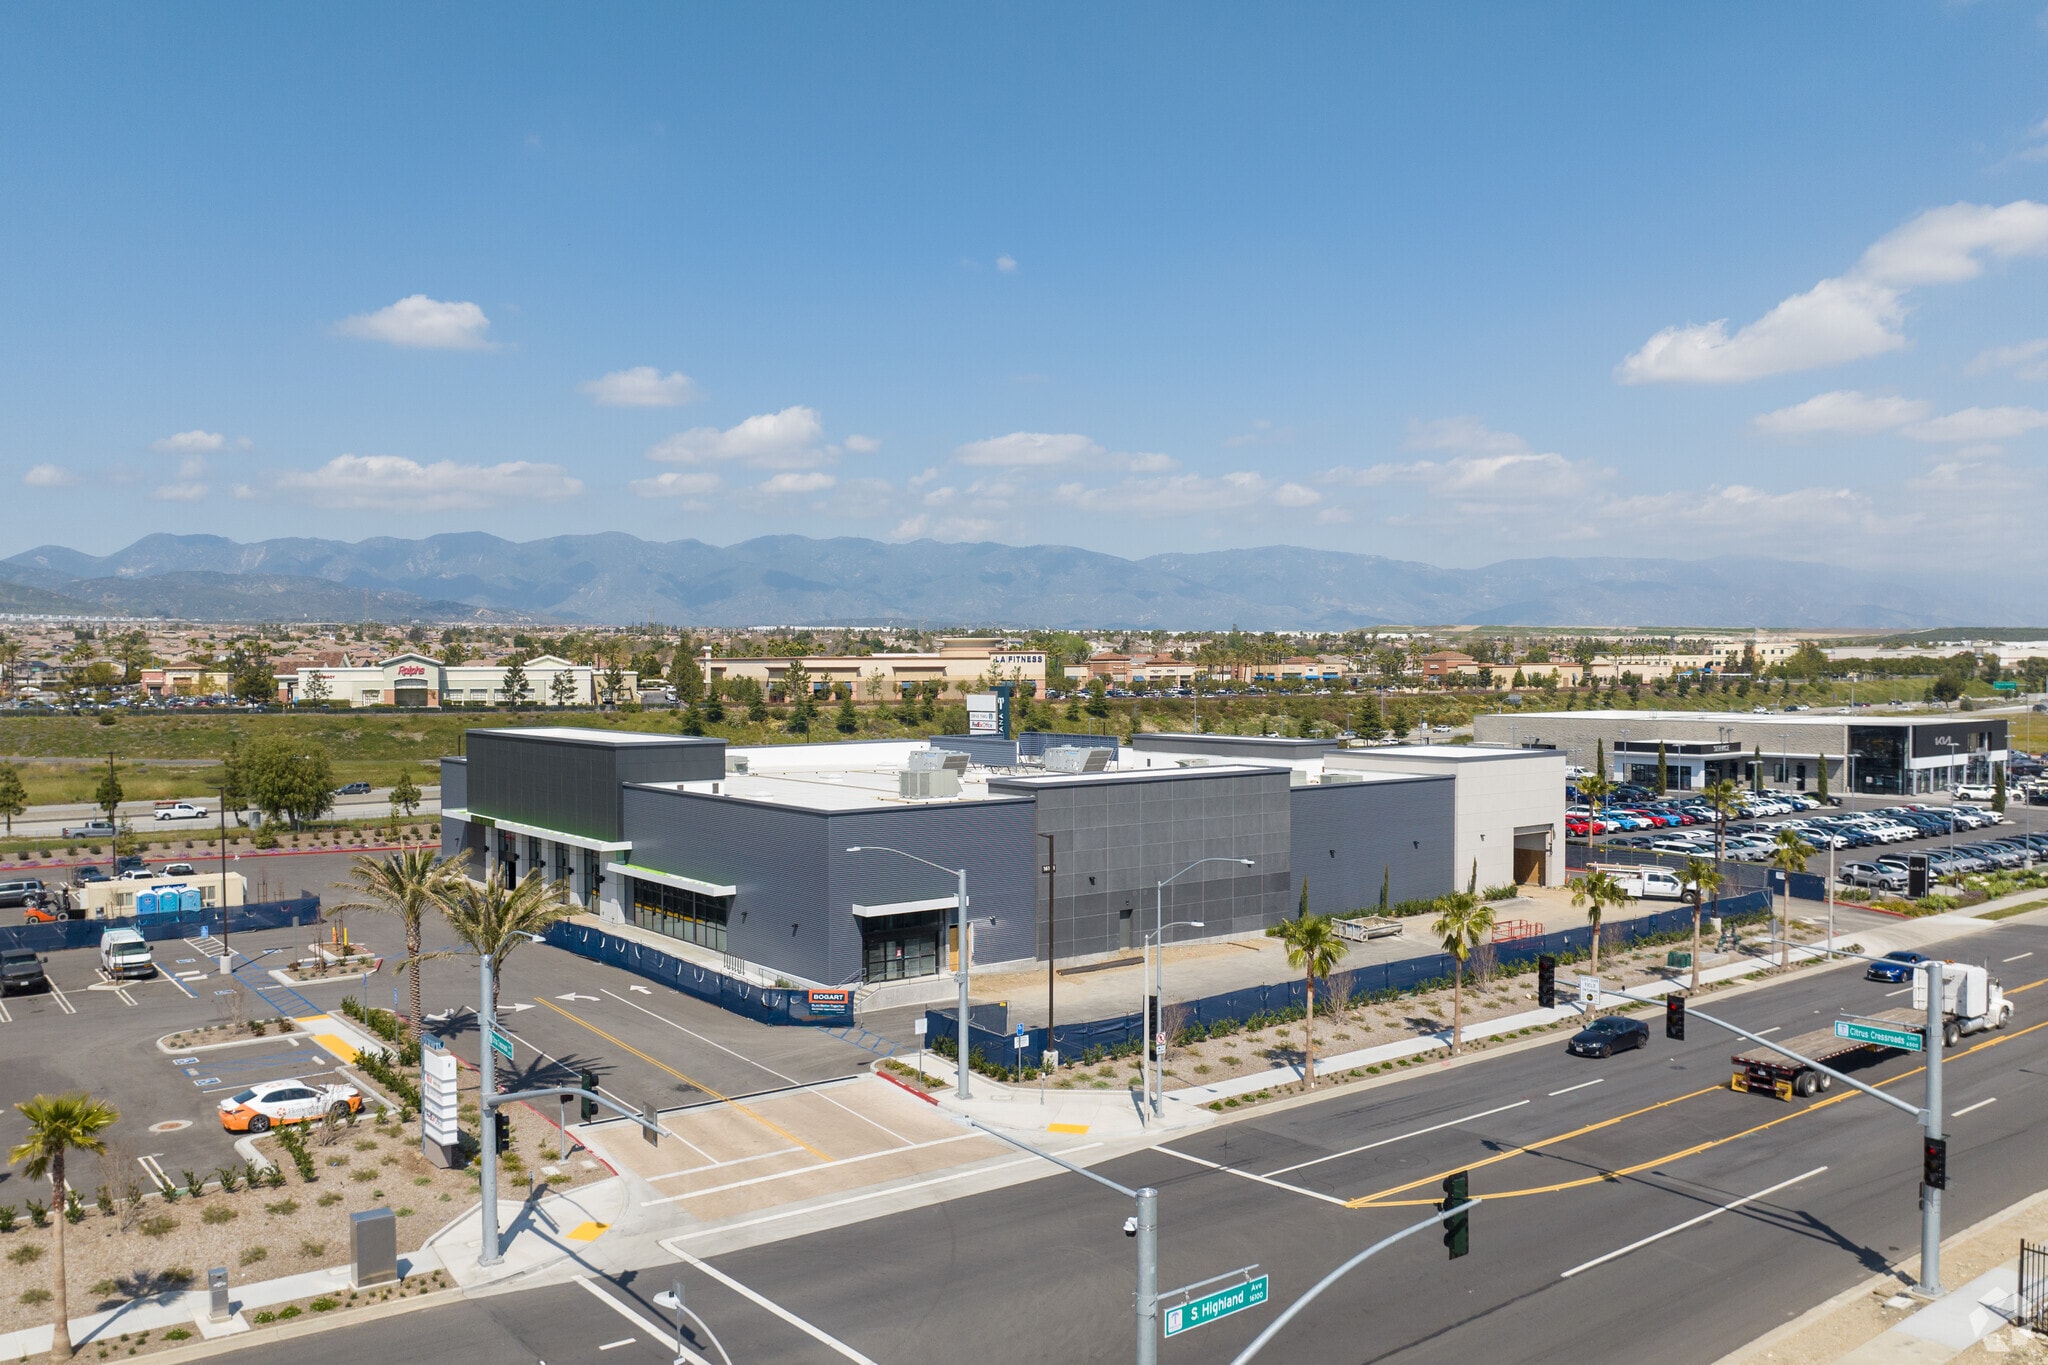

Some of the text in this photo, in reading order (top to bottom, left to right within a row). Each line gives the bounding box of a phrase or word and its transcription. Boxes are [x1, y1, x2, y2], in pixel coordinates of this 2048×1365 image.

[397, 665, 425, 677] Ralphs
[1849, 1028, 1869, 1039] Citrus
[1870, 1031, 1905, 1045] Crossroads
[1202, 1291, 1244, 1318] Highland
[1250, 1282, 1263, 1293] Ave
